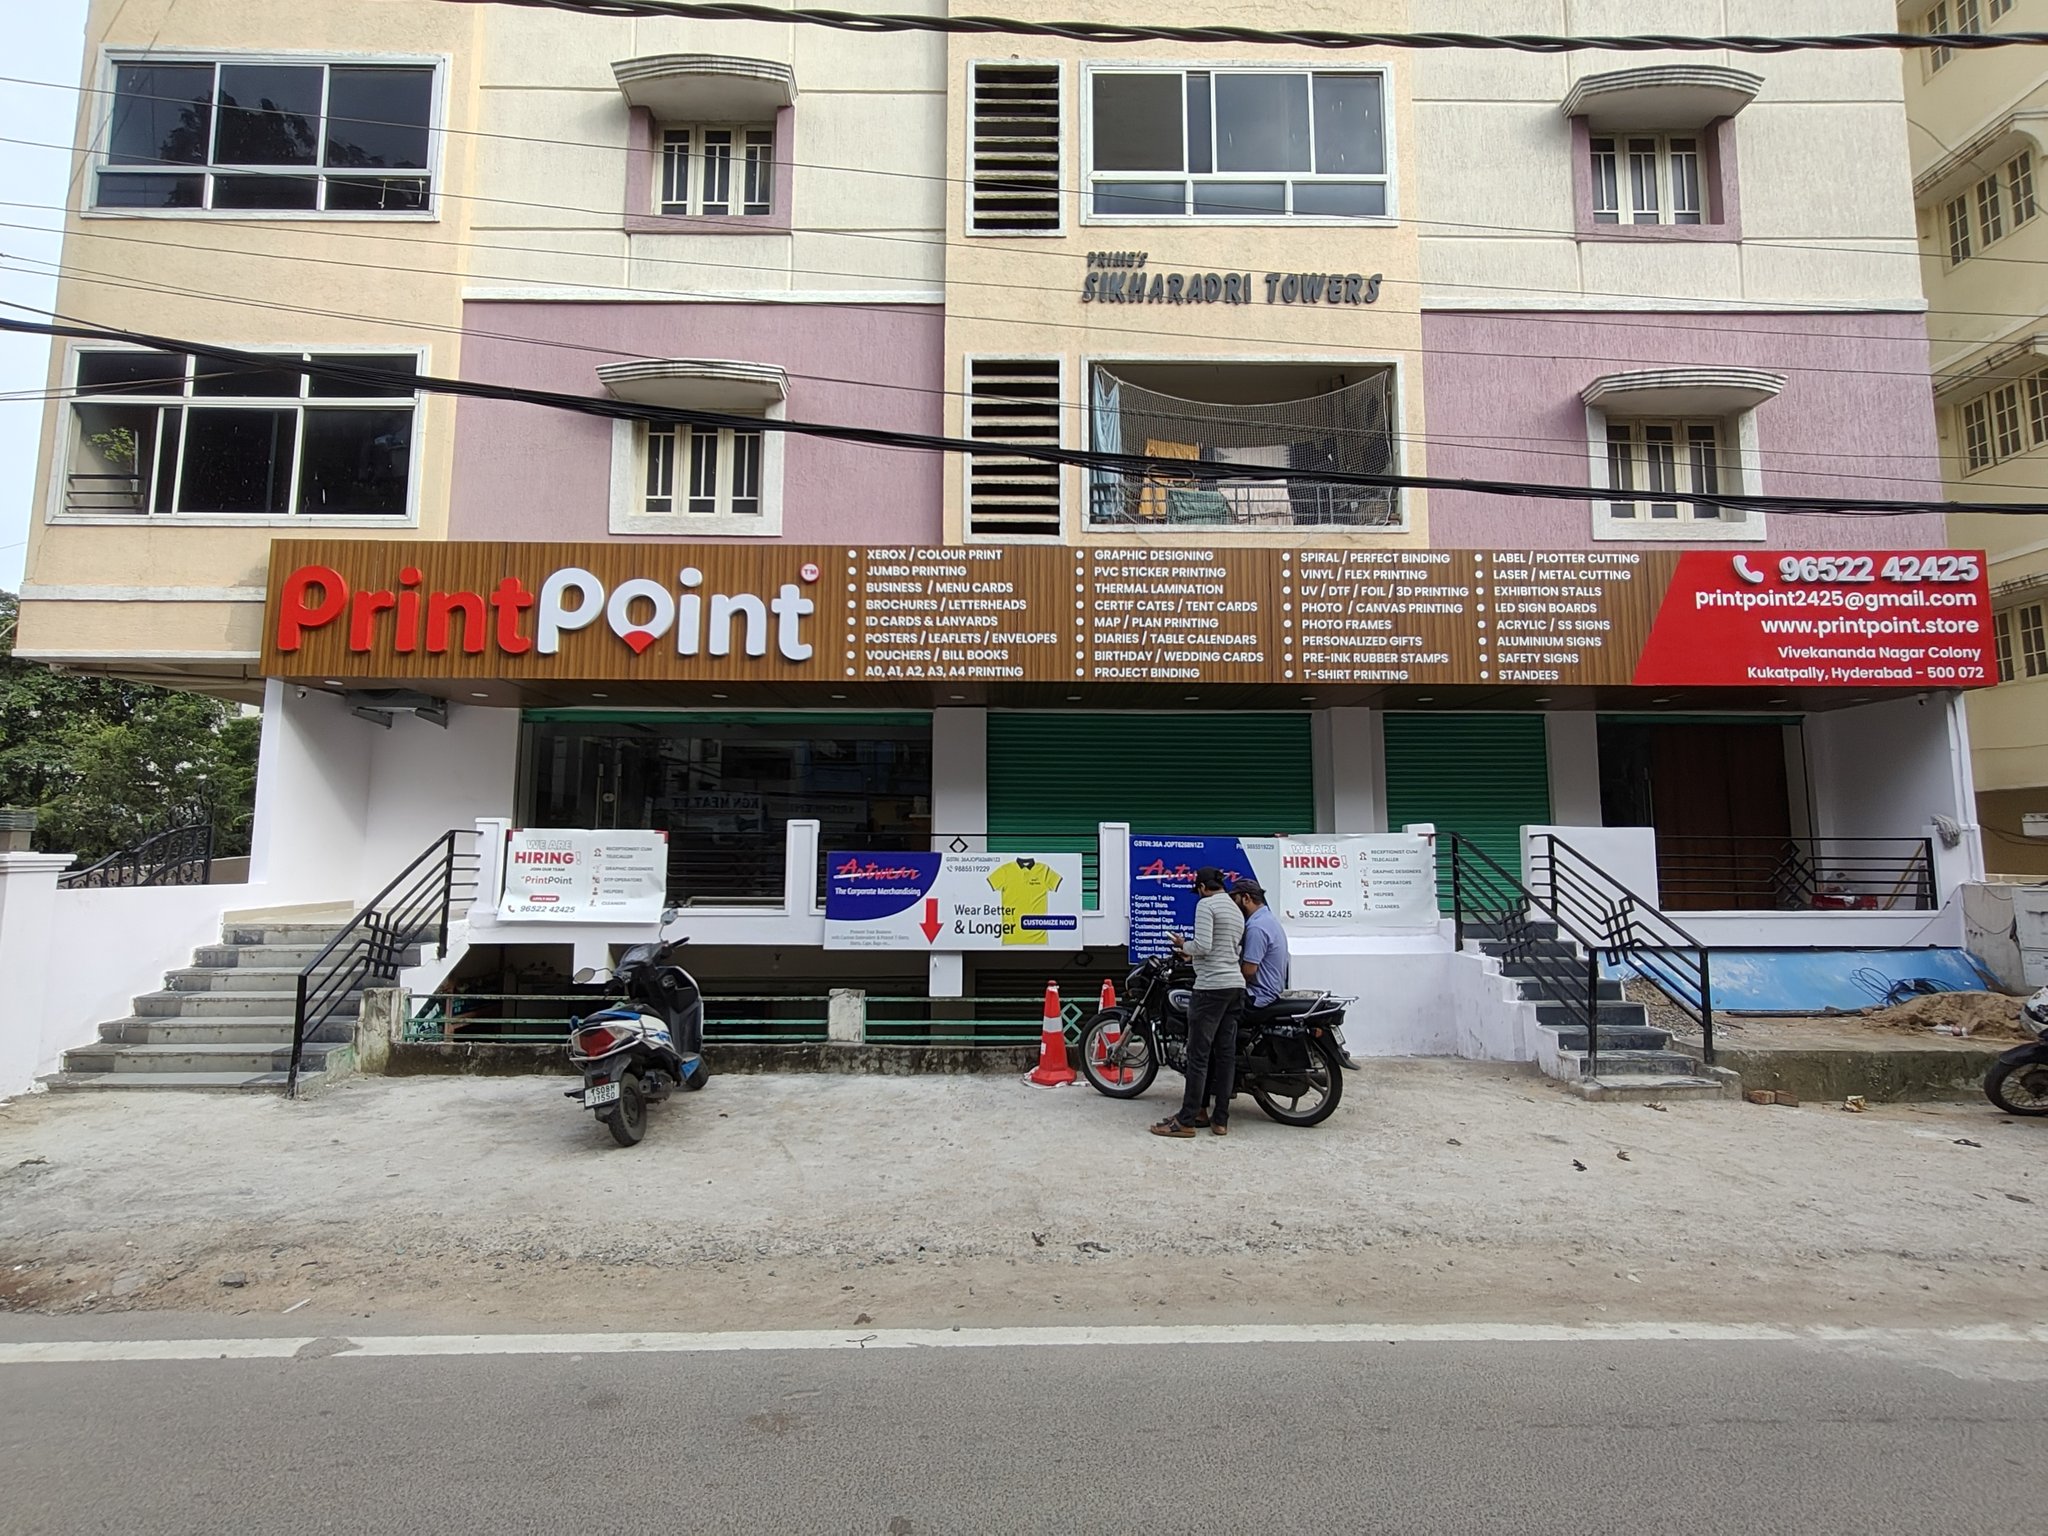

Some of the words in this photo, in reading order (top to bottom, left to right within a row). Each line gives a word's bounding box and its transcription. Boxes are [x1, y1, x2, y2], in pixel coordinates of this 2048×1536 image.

[1081, 270, 1252, 305] SIKHARADRI
[1265, 272, 1383, 305] TOWERS
[867, 550, 906, 560] XEROX
[918, 550, 966, 560] COLOUR
[969, 550, 1002, 560] PRINT
[1095, 550, 1147, 561] GRAPHIC
[1150, 550, 1213, 561] DESIGNING
[1301, 553, 1340, 563] SPIRAL
[1350, 553, 1399, 563] PERFECT
[1402, 553, 1450, 563] BINDING
[1493, 553, 1526, 564] LABEL
[1537, 553, 1585, 564] PLOTTER
[1588, 553, 1640, 564] CUTTING
[867, 566, 910, 576] JUMBO
[912, 566, 967, 576] PRINTING
[1094, 567, 1119, 577] PVC
[1122, 567, 1169, 577] STICKER
[1172, 567, 1226, 577] PRINTING
[1778, 556, 1875, 582] 96522
[1880, 556, 1979, 582] 42425
[1301, 570, 1334, 580] VINYL
[1345, 570, 1370, 580] FLEX
[1373, 570, 1428, 580] PRINTING
[1493, 570, 1528, 580] LASER
[1539, 570, 1577, 580] METAL
[1579, 570, 1631, 580] CUTTING
[866, 583, 922, 592] BUSINESS
[936, 583, 970, 592] MENU
[972, 583, 1013, 592] CARDS
[1095, 584, 1148, 594] THERMAL
[1151, 584, 1223, 594] LAMINATION
[1301, 586, 1318, 597] UV
[1329, 586, 1350, 597] DTF
[1361, 586, 1386, 597] FOIL
[1396, 586, 1412, 597] 3D
[1415, 586, 1469, 597] PRINTING
[1494, 587, 1559, 597] EXHIBITION
[1562, 587, 1602, 597] STALLS
[866, 600, 937, 610] BROCHURES
[948, 600, 1026, 610] LETTERHEADS
[1695, 589, 1977, 611] printpoint2425@gmail.com
[1186, 601, 1214, 612] TENT
[1217, 601, 1257, 612] CARDS
[1302, 603, 1342, 613] PHOTO
[1356, 603, 1406, 613] CANVAS
[1409, 603, 1463, 613] PRINTING
[1495, 604, 1515, 613] LED
[1518, 604, 1546, 613] SIGN
[1549, 604, 1597, 613] BOARDS
[276, 564, 814, 662] PrintPoint
[866, 616, 878, 626] ID
[880, 616, 921, 626] CARDS
[924, 616, 934, 626] &
[936, 616, 998, 626] LANYARDS
[1094, 617, 1121, 628] MAP
[1132, 617, 1161, 628] PLAN
[1164, 617, 1218, 628] PRINTING
[1302, 620, 1343, 630] PHOTO
[1346, 620, 1392, 630] FRAMES
[1497, 620, 1546, 630] ACRYLIC
[1558, 620, 1572, 630] SS
[1575, 620, 1610, 630] SIGNS
[1761, 616, 1979, 637] www.printpoint.store
[865, 633, 917, 643] POSTERS
[929, 633, 981, 643] LEAFLETS
[992, 633, 1057, 643] ENVELOPES
[1094, 634, 1139, 644] DIARIES
[1150, 634, 1184, 644] TABLE
[1187, 634, 1256, 644] CALENDARS
[1302, 637, 1387, 646] PERSONALIZED
[1390, 637, 1422, 646] GIFTS
[1497, 637, 1563, 646] ALUMINIUM
[1566, 637, 1602, 646] SIGNS
[866, 650, 931, 660] VOUCHERS
[942, 650, 964, 660] BILL
[967, 650, 1008, 660] BOOKS
[1095, 651, 1153, 662] BIRTHDAY
[1164, 651, 1220, 662] WEDDING
[1223, 651, 1264, 662] CARDS
[1303, 653, 1350, 663] PRE-INK
[1354, 653, 1398, 663] RUBBER
[1401, 653, 1449, 663] STAMPS
[1498, 654, 1540, 663] SAFETY
[1543, 654, 1579, 663] SIGNS
[1778, 646, 1876, 659] Vivekananda
[1879, 646, 1925, 661] Nagar
[1928, 646, 1981, 661] Colony
[865, 666, 885, 677] A0,
[887, 666, 903, 677] A1,
[906, 666, 925, 677] A2,
[927, 666, 946, 677] A3,
[949, 666, 966, 676] A4
[968, 666, 1023, 676] PRINTING
[1095, 668, 1148, 678] PROJECT
[1151, 668, 1200, 678] BINDING
[1304, 670, 1350, 680] T-SHIRT
[1354, 670, 1408, 680] PRINTING
[1499, 670, 1559, 680] STANDEES
[1747, 667, 1829, 681] Kukatpally,
[1832, 667, 1913, 681] Hyderabad
[1927, 667, 1956, 678] 500
[1958, 667, 1984, 678] 072
[526, 840, 546, 849] WE
[550, 840, 572, 849] ARE
[1291, 845, 1313, 854] WE
[1313, 845, 1337, 854] ARE
[834, 887, 846, 895] The
[847, 887, 876, 896] Corporate
[878, 887, 920, 896] Merchandising
[520, 905, 546, 913] 96522
[549, 905, 575, 913] 42425
[955, 905, 981, 916] Wear
[983, 905, 1015, 916] Better
[955, 921, 965, 935] &
[969, 919, 1016, 938] Longer
